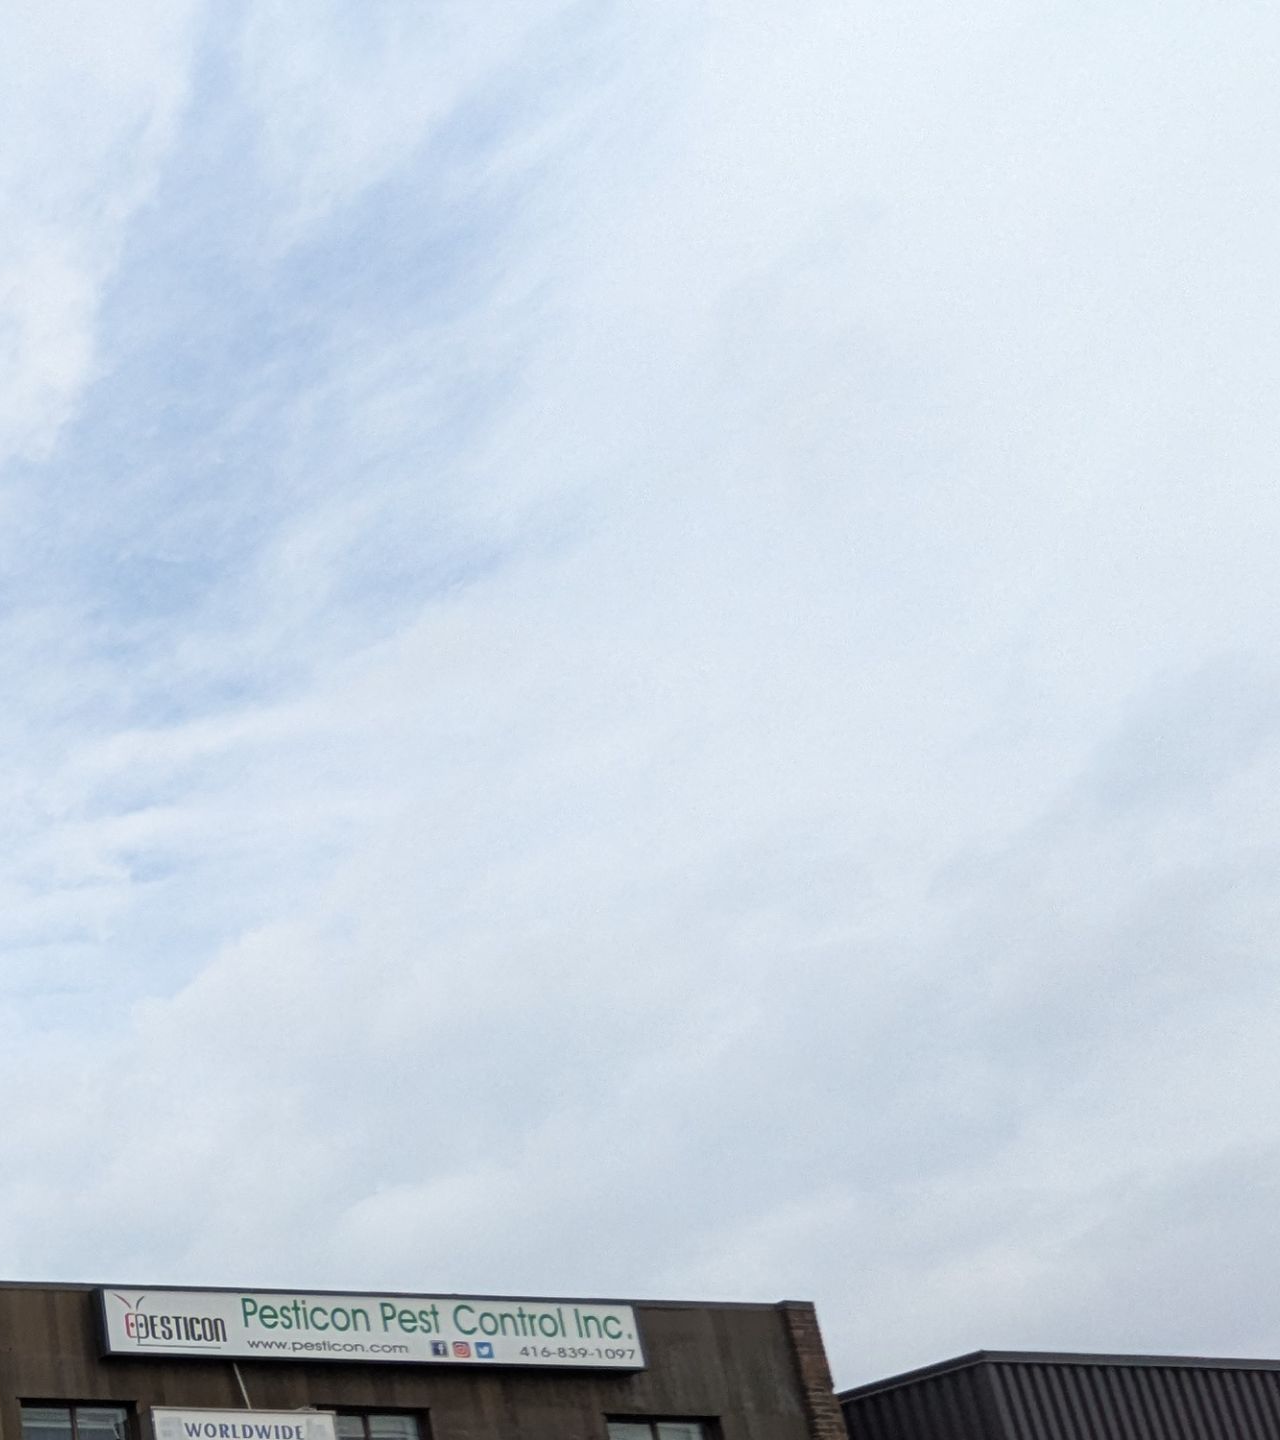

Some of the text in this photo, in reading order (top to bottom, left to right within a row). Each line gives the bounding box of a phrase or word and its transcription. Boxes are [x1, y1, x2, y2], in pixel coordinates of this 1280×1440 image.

[241, 1297, 633, 1340] Pesticon Pest Control Inc.
[247, 1339, 636, 1360] www.pesticon.com 416-839-1097
[184, 1422, 305, 1440] WORLDWIDE
